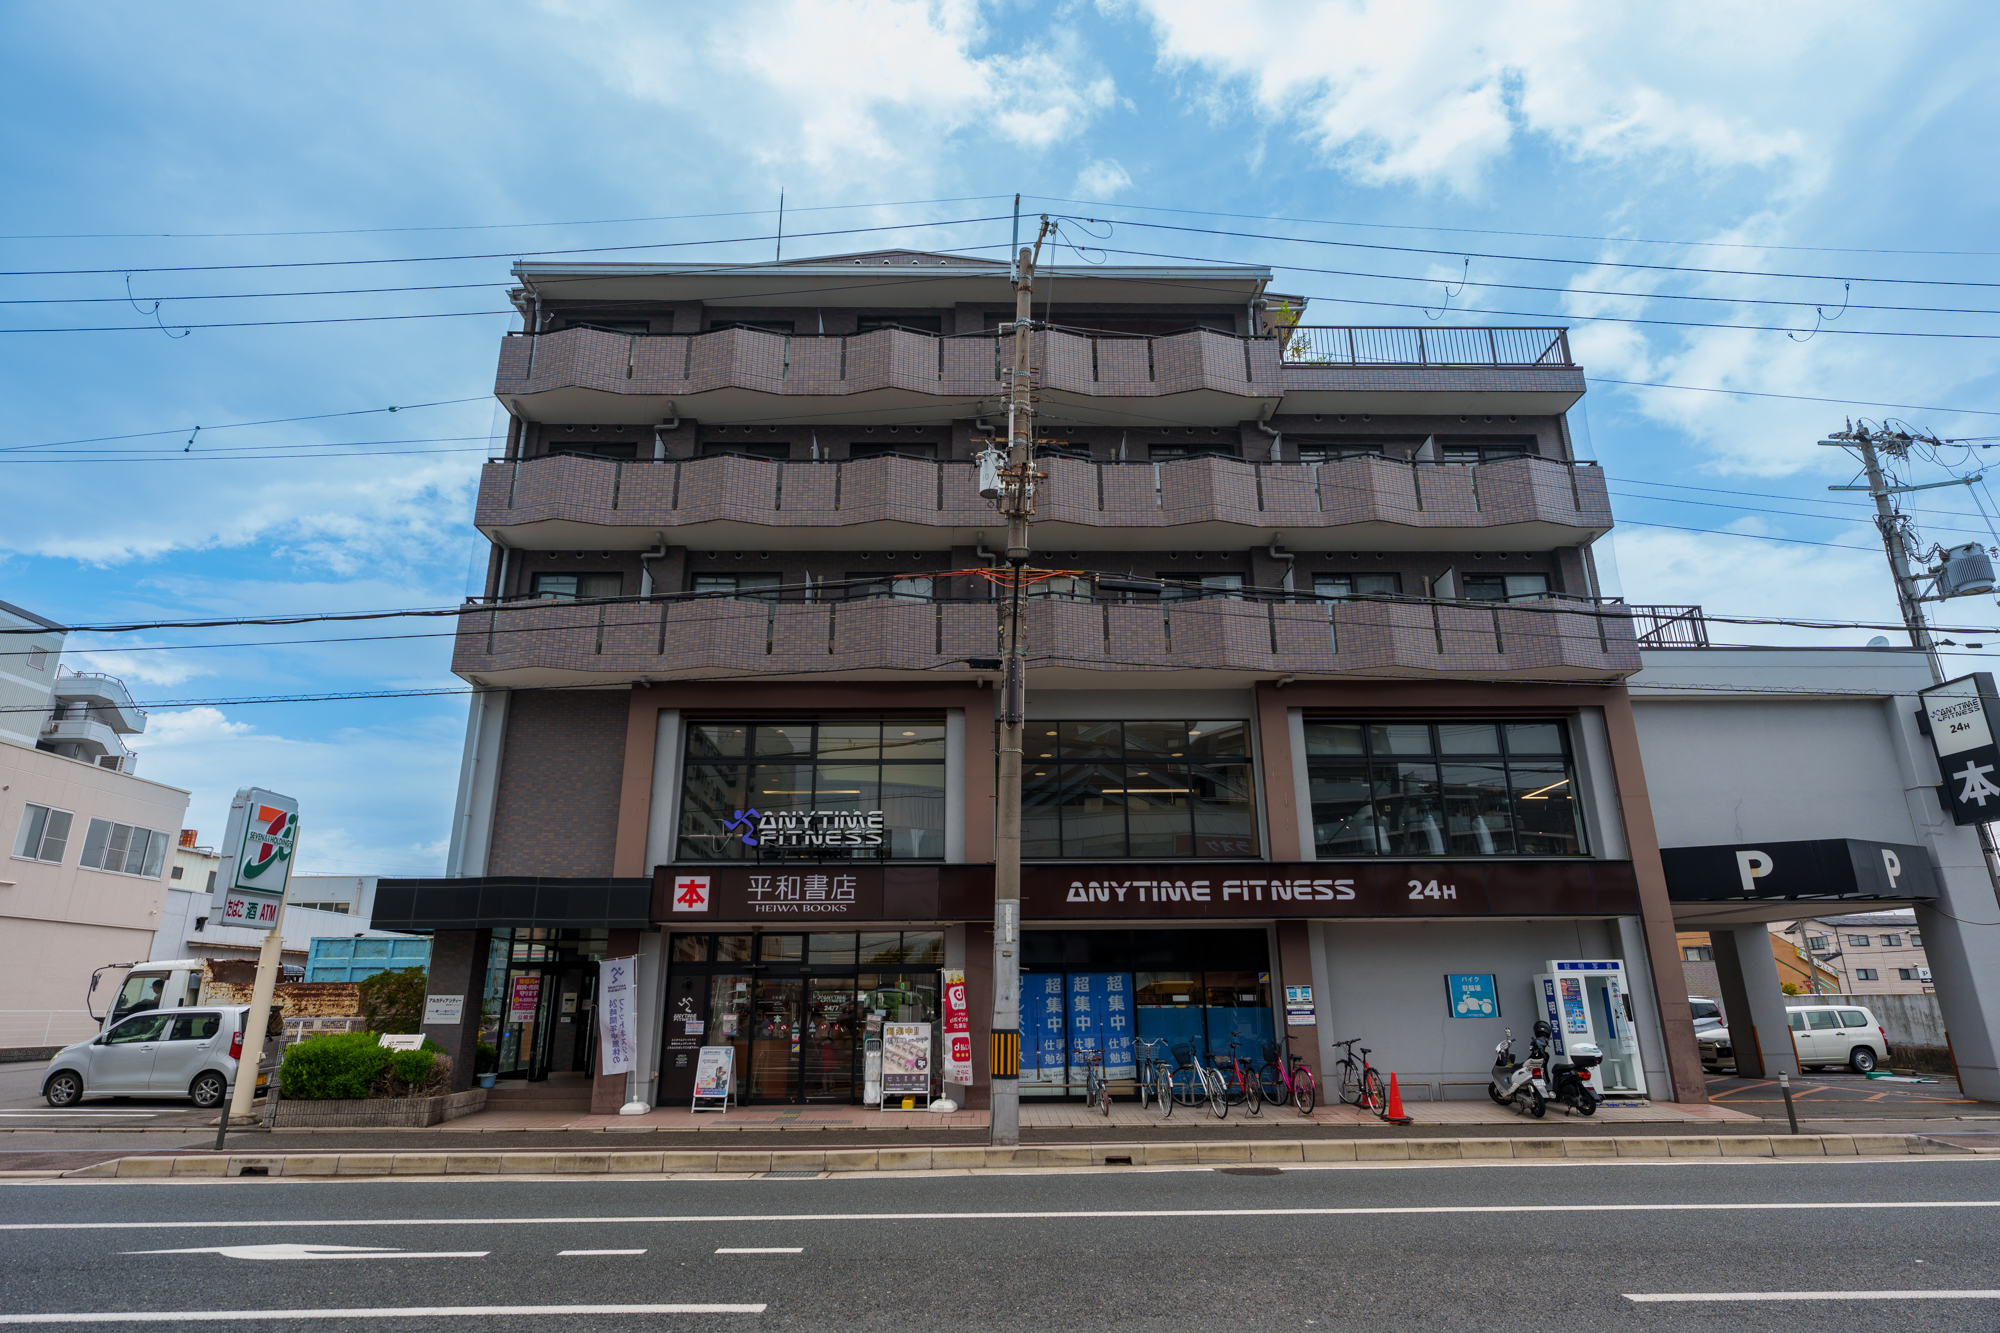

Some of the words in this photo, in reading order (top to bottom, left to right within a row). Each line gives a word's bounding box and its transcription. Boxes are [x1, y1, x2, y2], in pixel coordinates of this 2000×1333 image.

[1940, 698, 1979, 716] ANYTIME
[1942, 706, 1981, 721] FITNESS
[1950, 722, 1970, 733] 24H
[1953, 760, 2000, 806] 本
[759, 810, 884, 829] ANYTIME
[760, 830, 883, 846] FITNESS
[1735, 850, 1774, 890] P
[1881, 849, 1901, 888] P
[677, 879, 707, 908] 本
[747, 874, 857, 900] 平和書店
[1066, 880, 1211, 902] ANYTIME
[1222, 879, 1356, 901] FITNESS
[1408, 879, 1458, 900] 24H
[225, 899, 244, 918] たばこ
[245, 902, 258, 919] 酒
[259, 903, 277, 922] ATM
[755, 904, 798, 912] HEIWA
[802, 904, 847, 912] BOOKS
[1045, 978, 1063, 1033] 超集中
[1073, 976, 1091, 1032] 超集中
[1107, 975, 1126, 1032] 超集中
[1545, 982, 1563, 1053] 証明写真
[1044, 1039, 1065, 1051] 仕事
[1073, 1038, 1095, 1050] 仕事
[1108, 1037, 1130, 1049] 仕事
[1044, 1053, 1065, 1065] 勉強
[1109, 1052, 1131, 1063] 勉強
